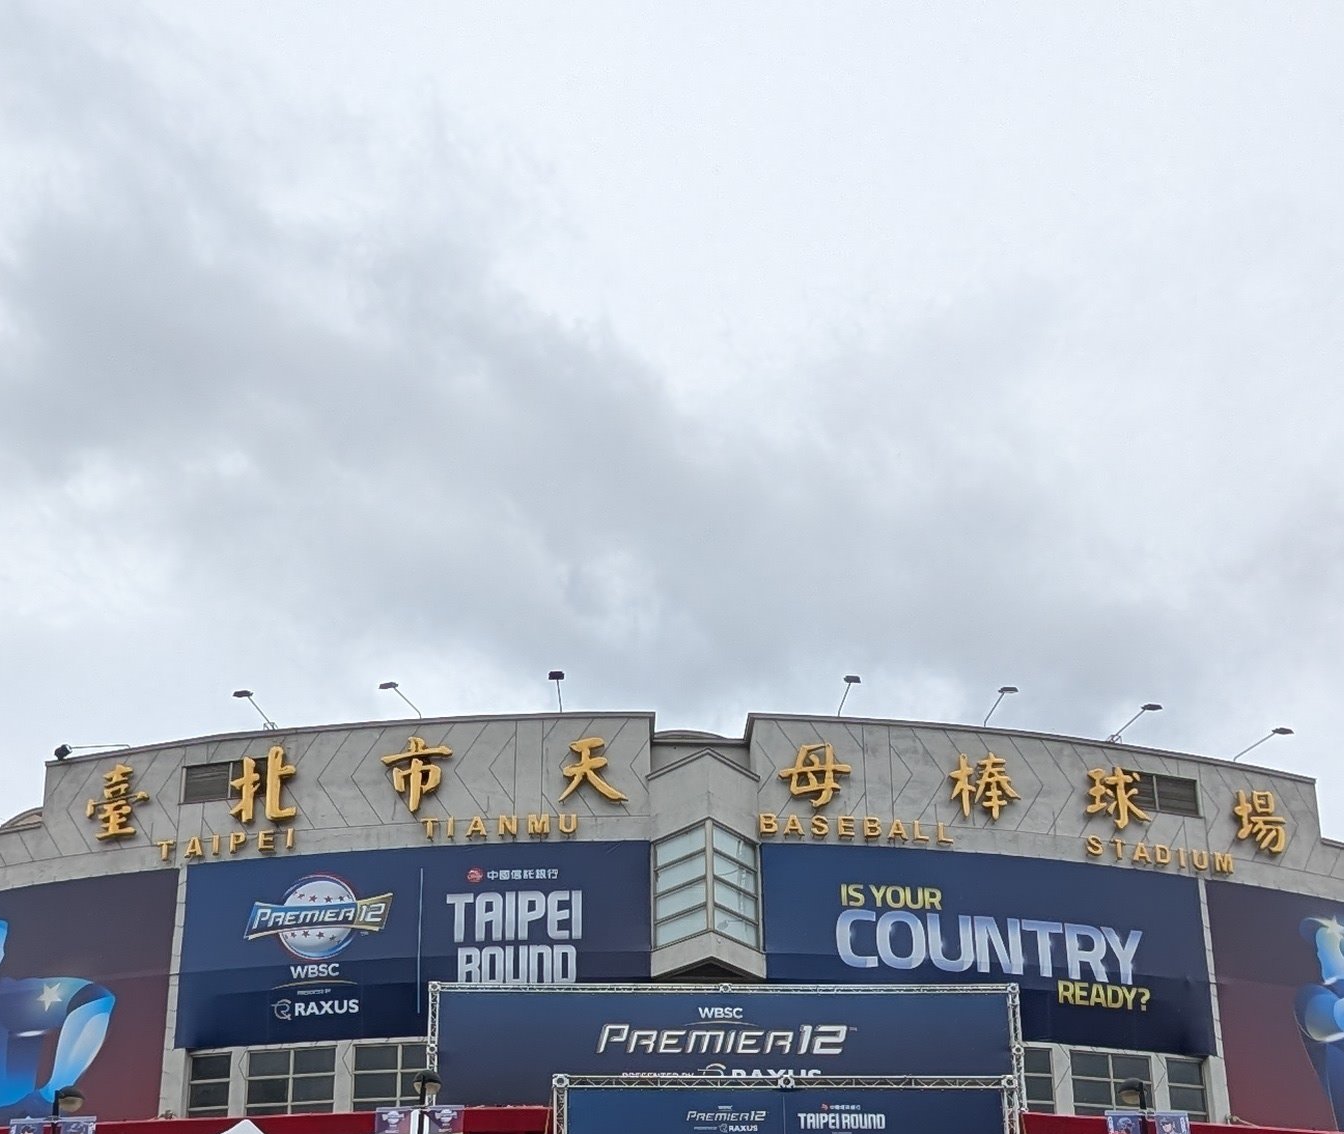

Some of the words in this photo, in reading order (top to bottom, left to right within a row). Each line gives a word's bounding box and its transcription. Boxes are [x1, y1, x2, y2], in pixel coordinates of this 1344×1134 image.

[157, 827, 296, 862] TAIPEI
[422, 812, 579, 841] TIANMU
[759, 812, 954, 845] BASEBALL
[1086, 836, 1236, 875] STADIUM
[487, 868, 558, 880] 中國信託銀行
[840, 884, 864, 908] IS
[870, 885, 942, 911] YOUR
[446, 890, 582, 942] TAIPEI
[836, 909, 1142, 986] COUNTRY
[290, 963, 340, 979] WBSC
[458, 944, 576, 983] ROUND
[294, 999, 359, 1016] RAXUS
[1058, 979, 1150, 1012] READY?
[699, 1007, 743, 1019] WBSC
[797, 1112, 839, 1130] TAIPEI
[841, 1113, 886, 1130] ROUND
